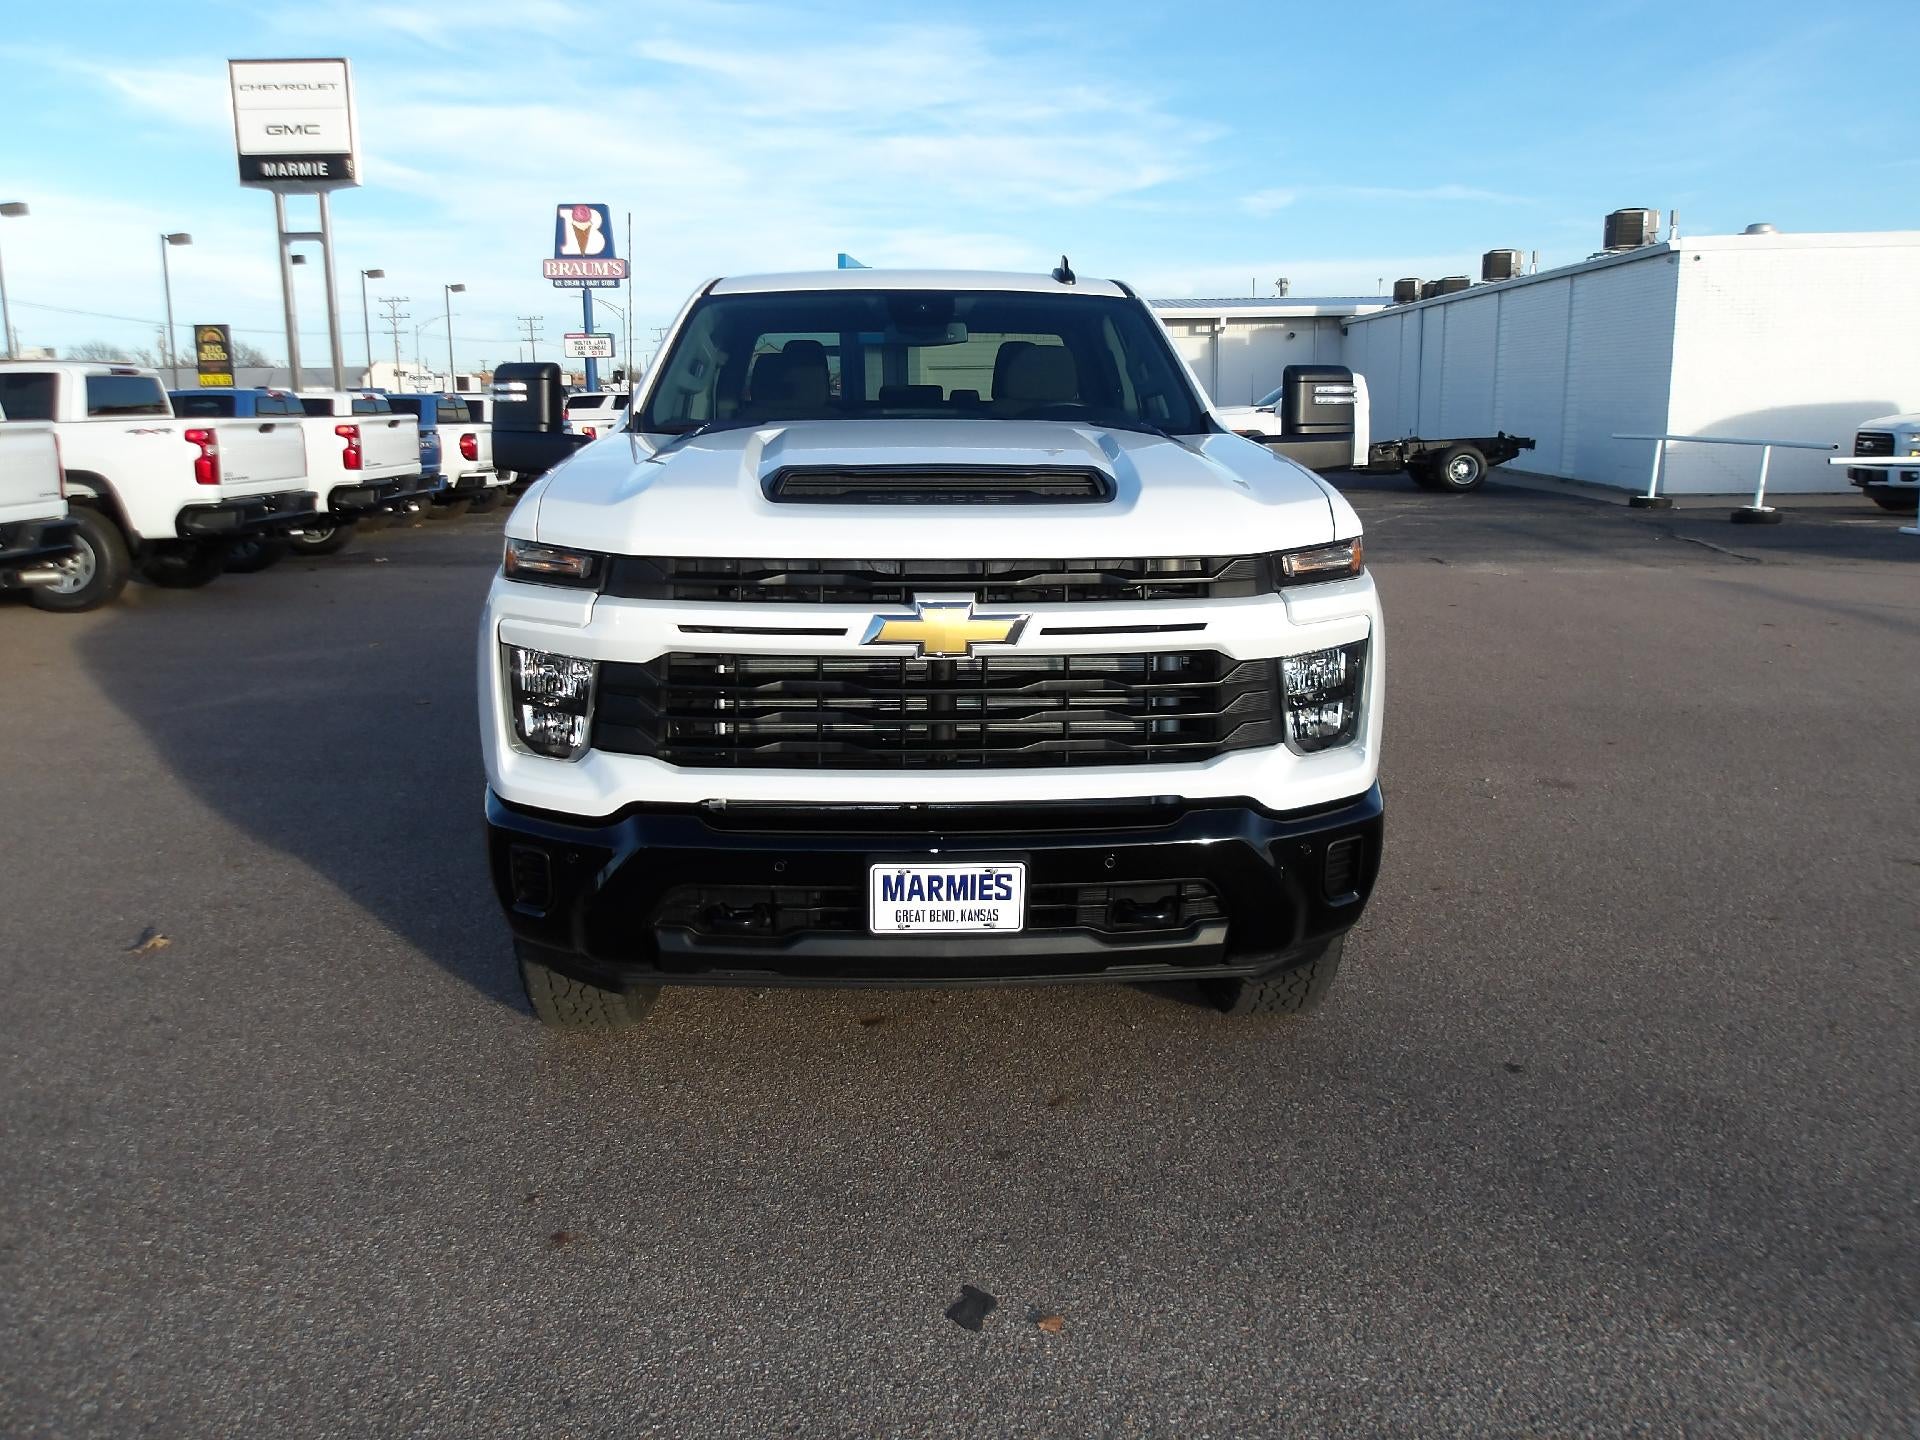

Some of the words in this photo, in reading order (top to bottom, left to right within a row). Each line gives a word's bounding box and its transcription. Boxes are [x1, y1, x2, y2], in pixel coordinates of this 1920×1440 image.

[239, 83, 338, 91] CHEVROLET
[266, 124, 321, 135] GMC
[263, 161, 329, 177] MARMIE
[545, 262, 624, 276] BRAUM'S
[882, 873, 1013, 902] MARMIES
[895, 909, 926, 923] GREAT
[929, 908, 959, 923] BEND,
[960, 908, 999, 922] KANSAS
